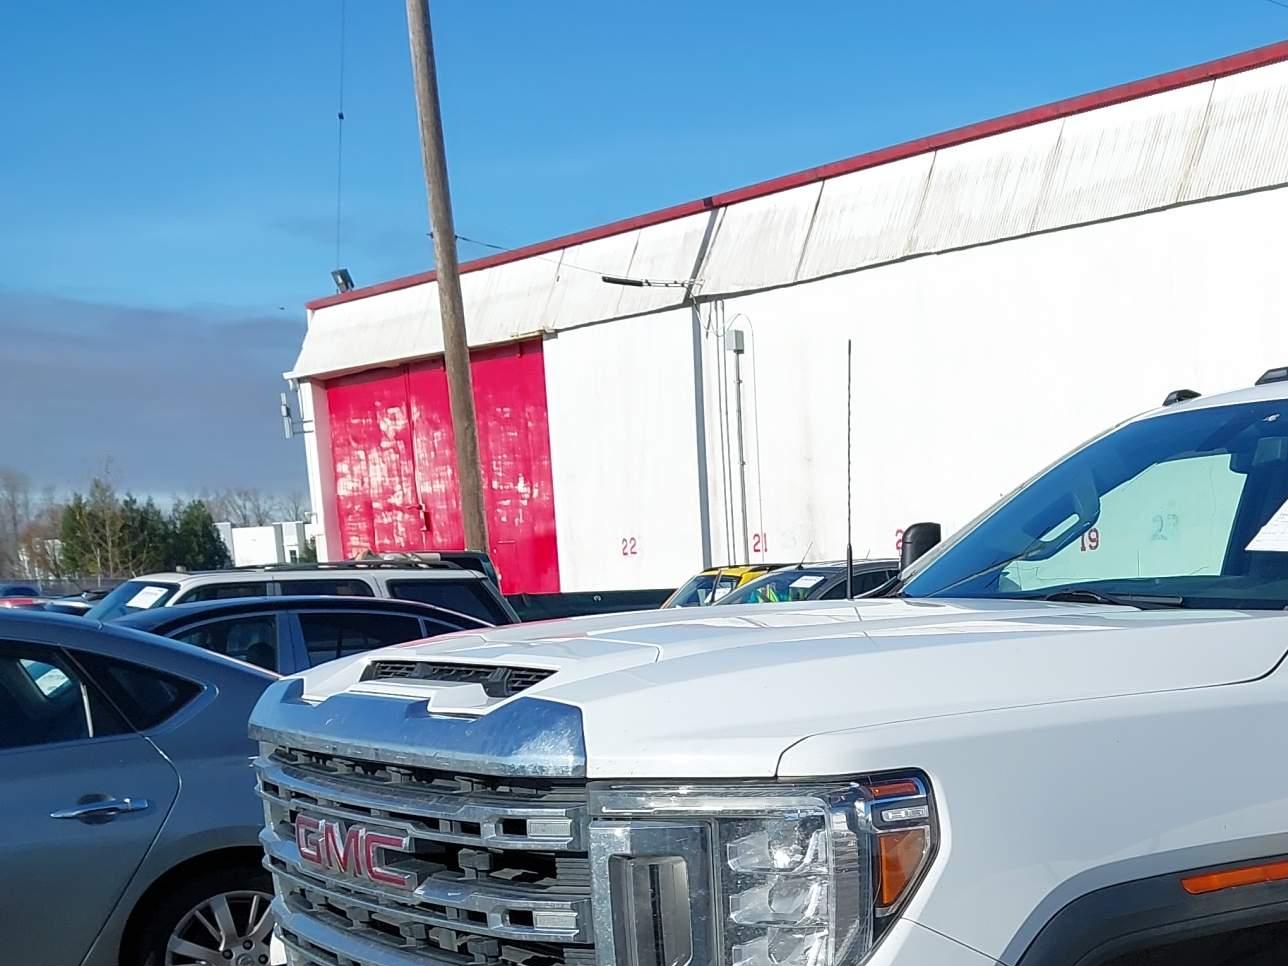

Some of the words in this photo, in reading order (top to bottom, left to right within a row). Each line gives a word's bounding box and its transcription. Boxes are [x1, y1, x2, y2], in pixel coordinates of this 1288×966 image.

[621, 536, 638, 556] 22
[753, 532, 768, 552] 21
[1081, 527, 1100, 552] 19
[887, 807, 926, 820] HD
[296, 814, 413, 887] GMC
